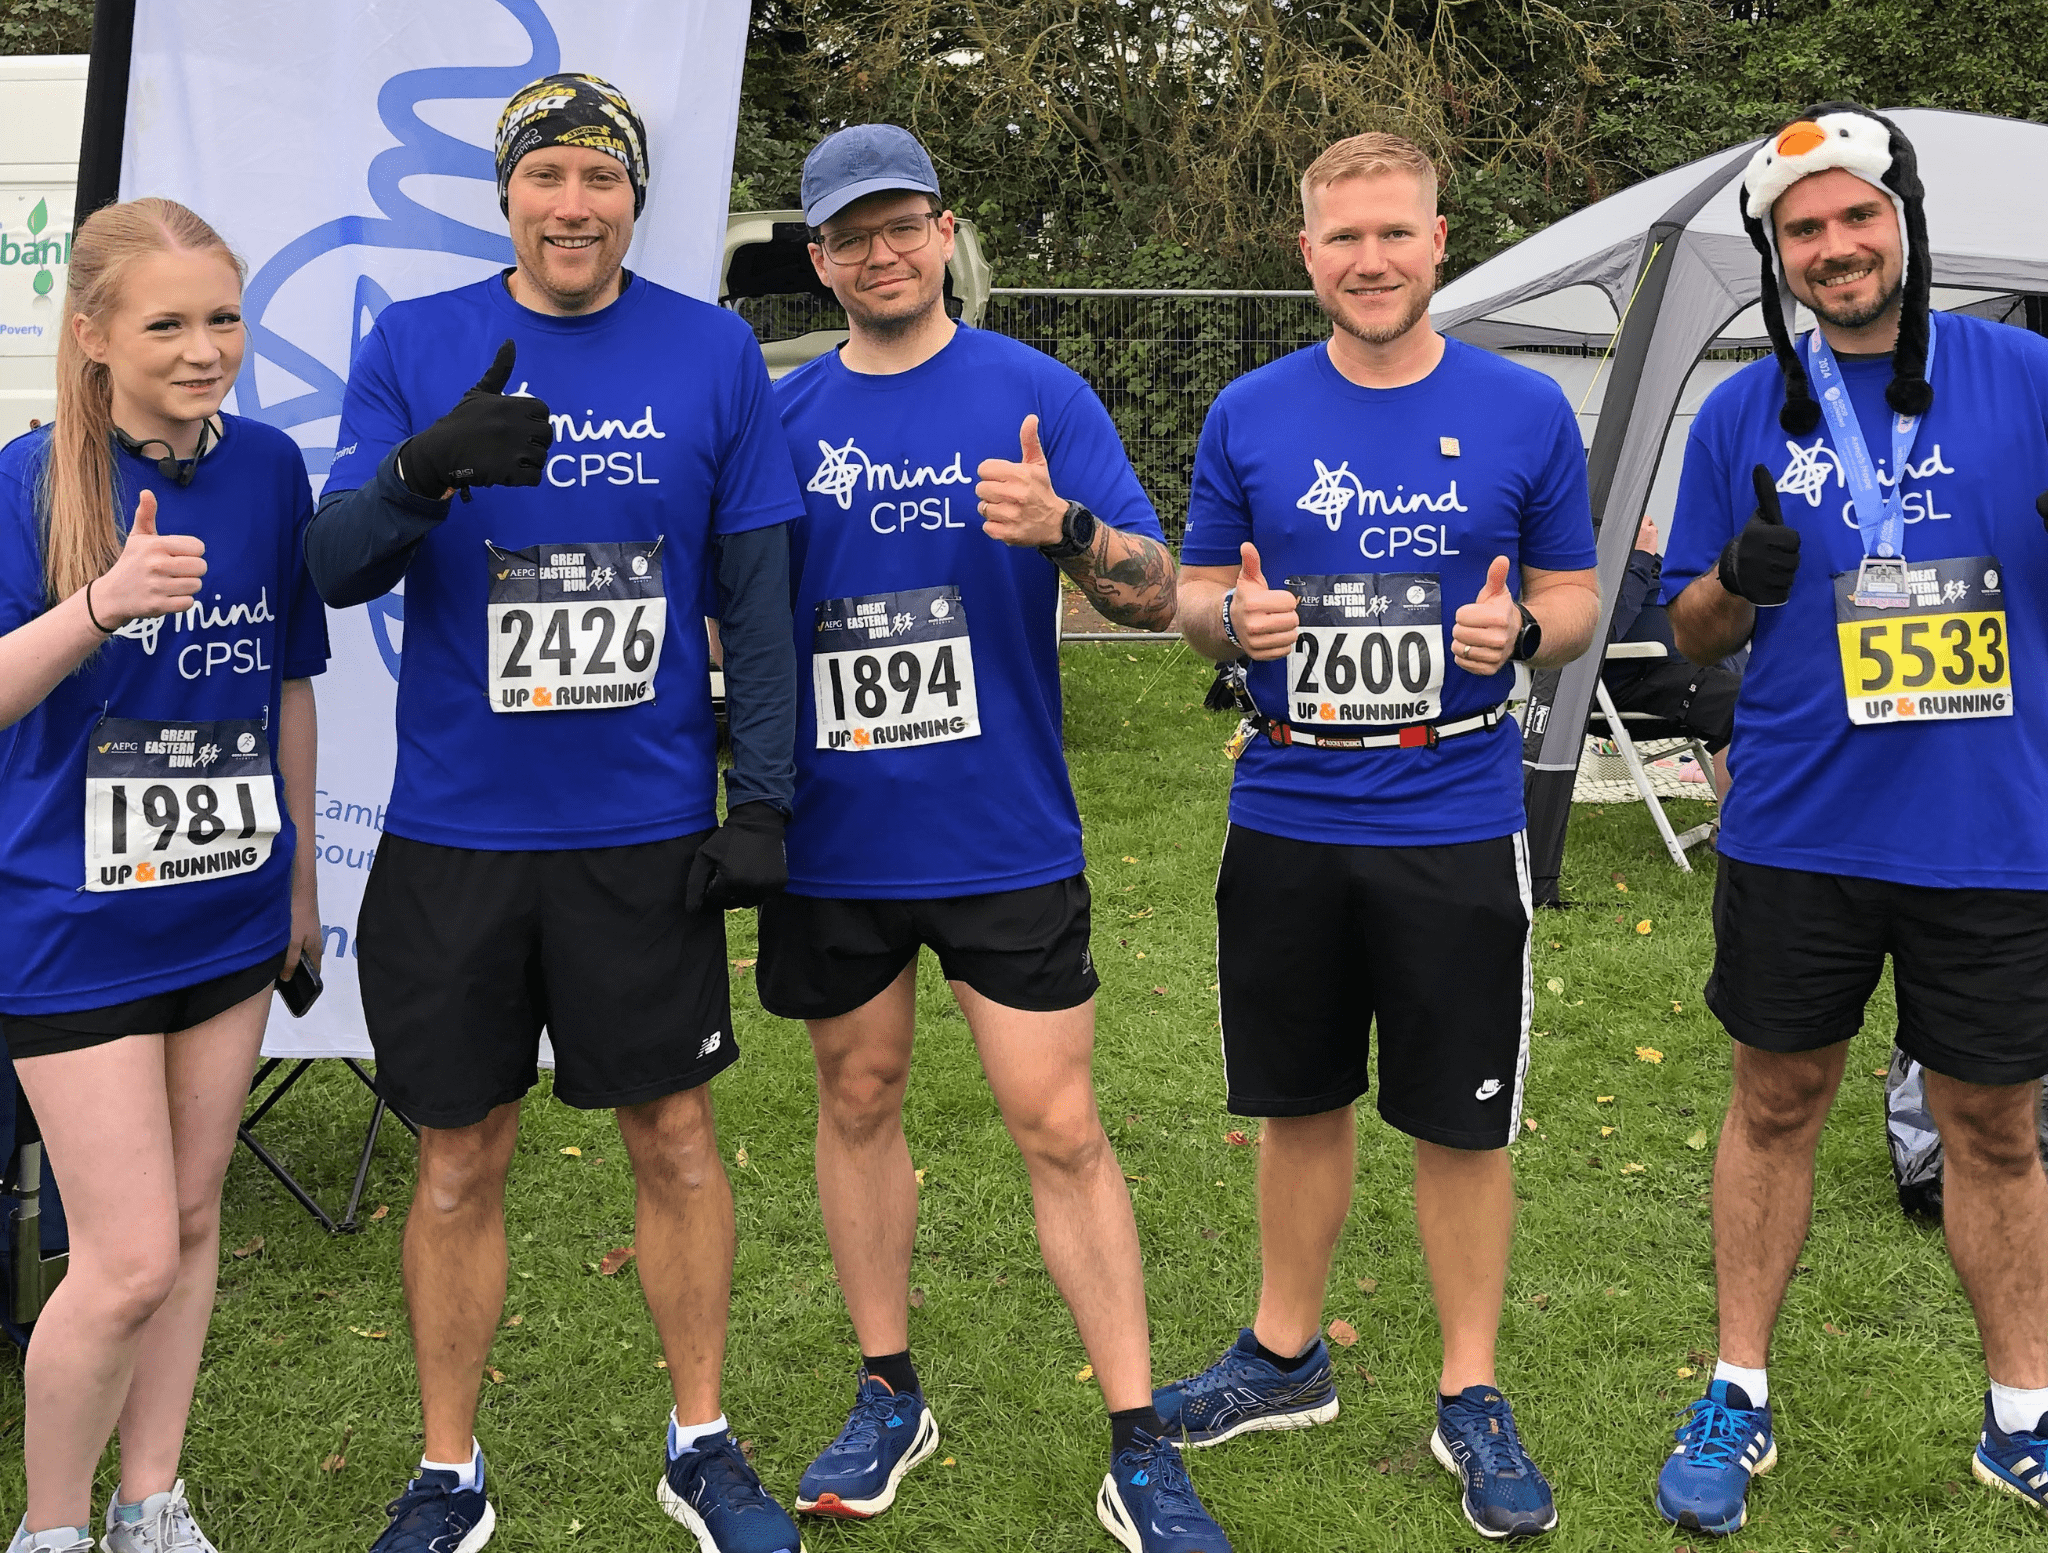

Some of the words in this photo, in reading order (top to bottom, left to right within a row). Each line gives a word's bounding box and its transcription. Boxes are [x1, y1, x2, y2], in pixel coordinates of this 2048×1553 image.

[0, 324, 43, 337] Poverty
[548, 406, 665, 442] mind
[547, 452, 660, 488] CPSL
[867, 452, 972, 492] mind
[1358, 480, 1468, 516] mind
[871, 497, 966, 534] CPSL
[1842, 489, 1952, 530] CSL
[1359, 524, 1460, 559] CPSL
[550, 553, 587, 566] GREAT
[509, 568, 536, 577] AEPG
[539, 565, 587, 580] EASTERN
[562, 579, 588, 593] RUN
[1333, 582, 1365, 594] GREAT
[1908, 581, 1940, 595] STERN
[175, 586, 275, 633] mind
[856, 601, 887, 616] GREAT
[1301, 596, 1320, 604] AEPG
[1322, 594, 1366, 607] EASTERN
[1916, 593, 1942, 607] RUN
[847, 614, 889, 630] EASTERN
[1222, 600, 1230, 623] HELP
[1344, 606, 1366, 618] RUN
[824, 619, 843, 629] AEPG
[868, 626, 890, 640] RUN
[500, 605, 655, 679] 2426
[178, 637, 271, 680] CPSL
[1294, 631, 1431, 695] 2600
[1859, 617, 2005, 691] 5533
[828, 645, 962, 721] 1894
[502, 688, 530, 708] UP
[531, 686, 553, 707] &
[556, 681, 647, 706] RUNNING
[1297, 702, 1318, 720] UP
[1319, 702, 1336, 721] &
[1339, 700, 1430, 721] RUNNING
[1865, 699, 1893, 719] UP
[1896, 697, 1916, 717] &
[1919, 693, 2005, 715] RUNNING
[160, 729, 198, 742] GREAT
[828, 729, 851, 748] UP
[853, 728, 871, 747] &
[872, 716, 966, 745] RUNNING
[111, 742, 138, 751] AEPG
[144, 742, 195, 755] EASTERN
[168, 755, 194, 768] RUN
[111, 783, 257, 855] 1981
[100, 864, 133, 886] UP
[135, 861, 156, 883] &
[160, 846, 258, 880] RUNNING
